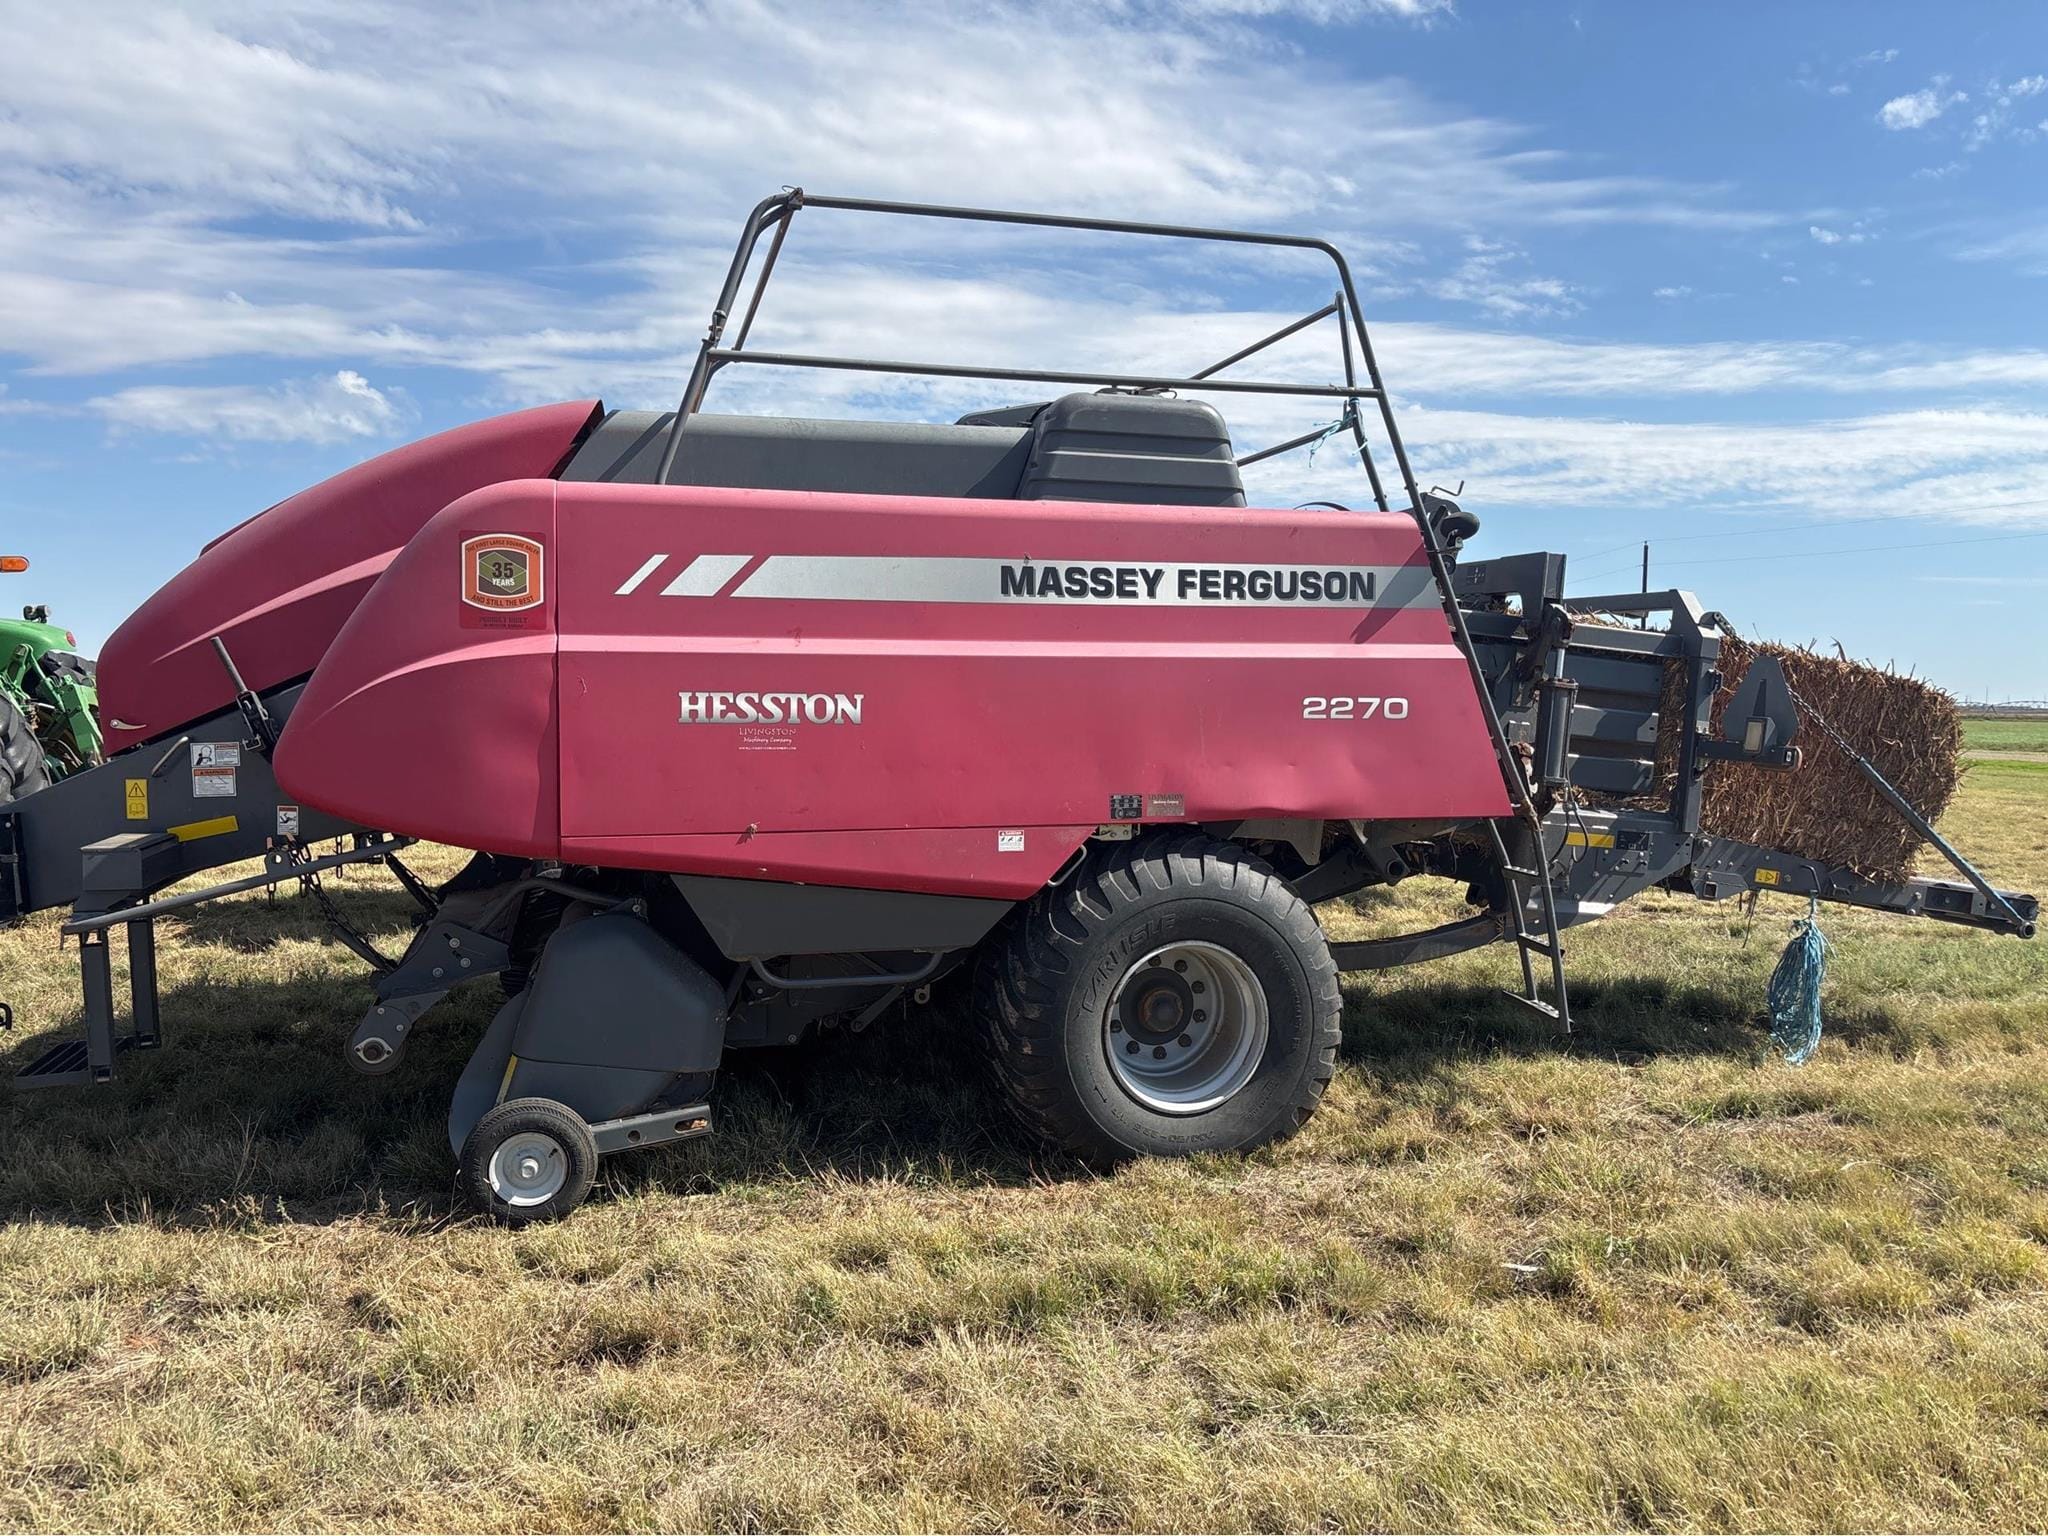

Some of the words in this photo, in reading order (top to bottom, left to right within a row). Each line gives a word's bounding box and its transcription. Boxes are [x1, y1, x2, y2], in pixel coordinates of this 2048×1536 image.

[492, 562, 513, 578] 35
[492, 578, 515, 586] YEARS
[999, 564, 1165, 600] MASSEY
[1176, 569, 1377, 601] FERGUSON
[471, 595, 486, 605] AND
[486, 598, 504, 607] STILL
[505, 599, 518, 607] THE
[519, 596, 534, 605] BEST
[678, 691, 865, 725] HESSTON
[1302, 696, 1409, 720] 2270
[739, 727, 797, 736] LIVINGSTON
[1081, 912, 1177, 1014] CARLISLE
